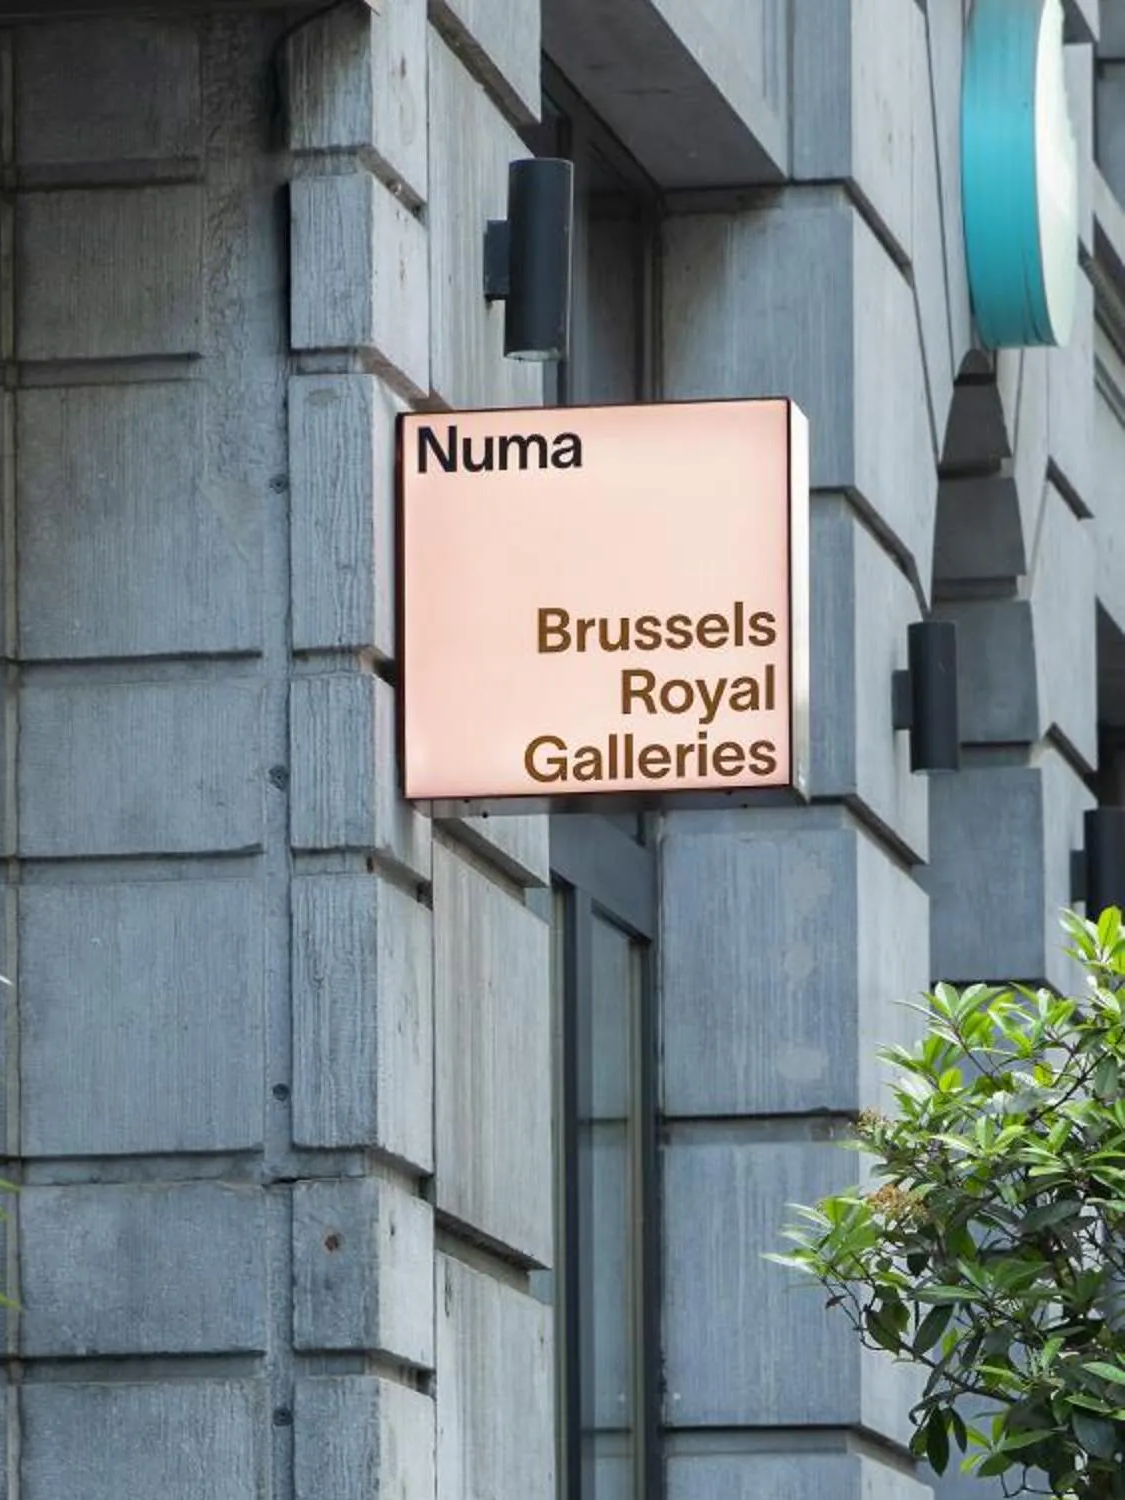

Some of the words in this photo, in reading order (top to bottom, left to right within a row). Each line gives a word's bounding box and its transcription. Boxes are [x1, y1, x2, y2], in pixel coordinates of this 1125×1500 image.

[417, 425, 582, 473] Numa
[537, 602, 777, 653] Brussels
[621, 664, 775, 724] Royal
[524, 731, 777, 782] Galleries
